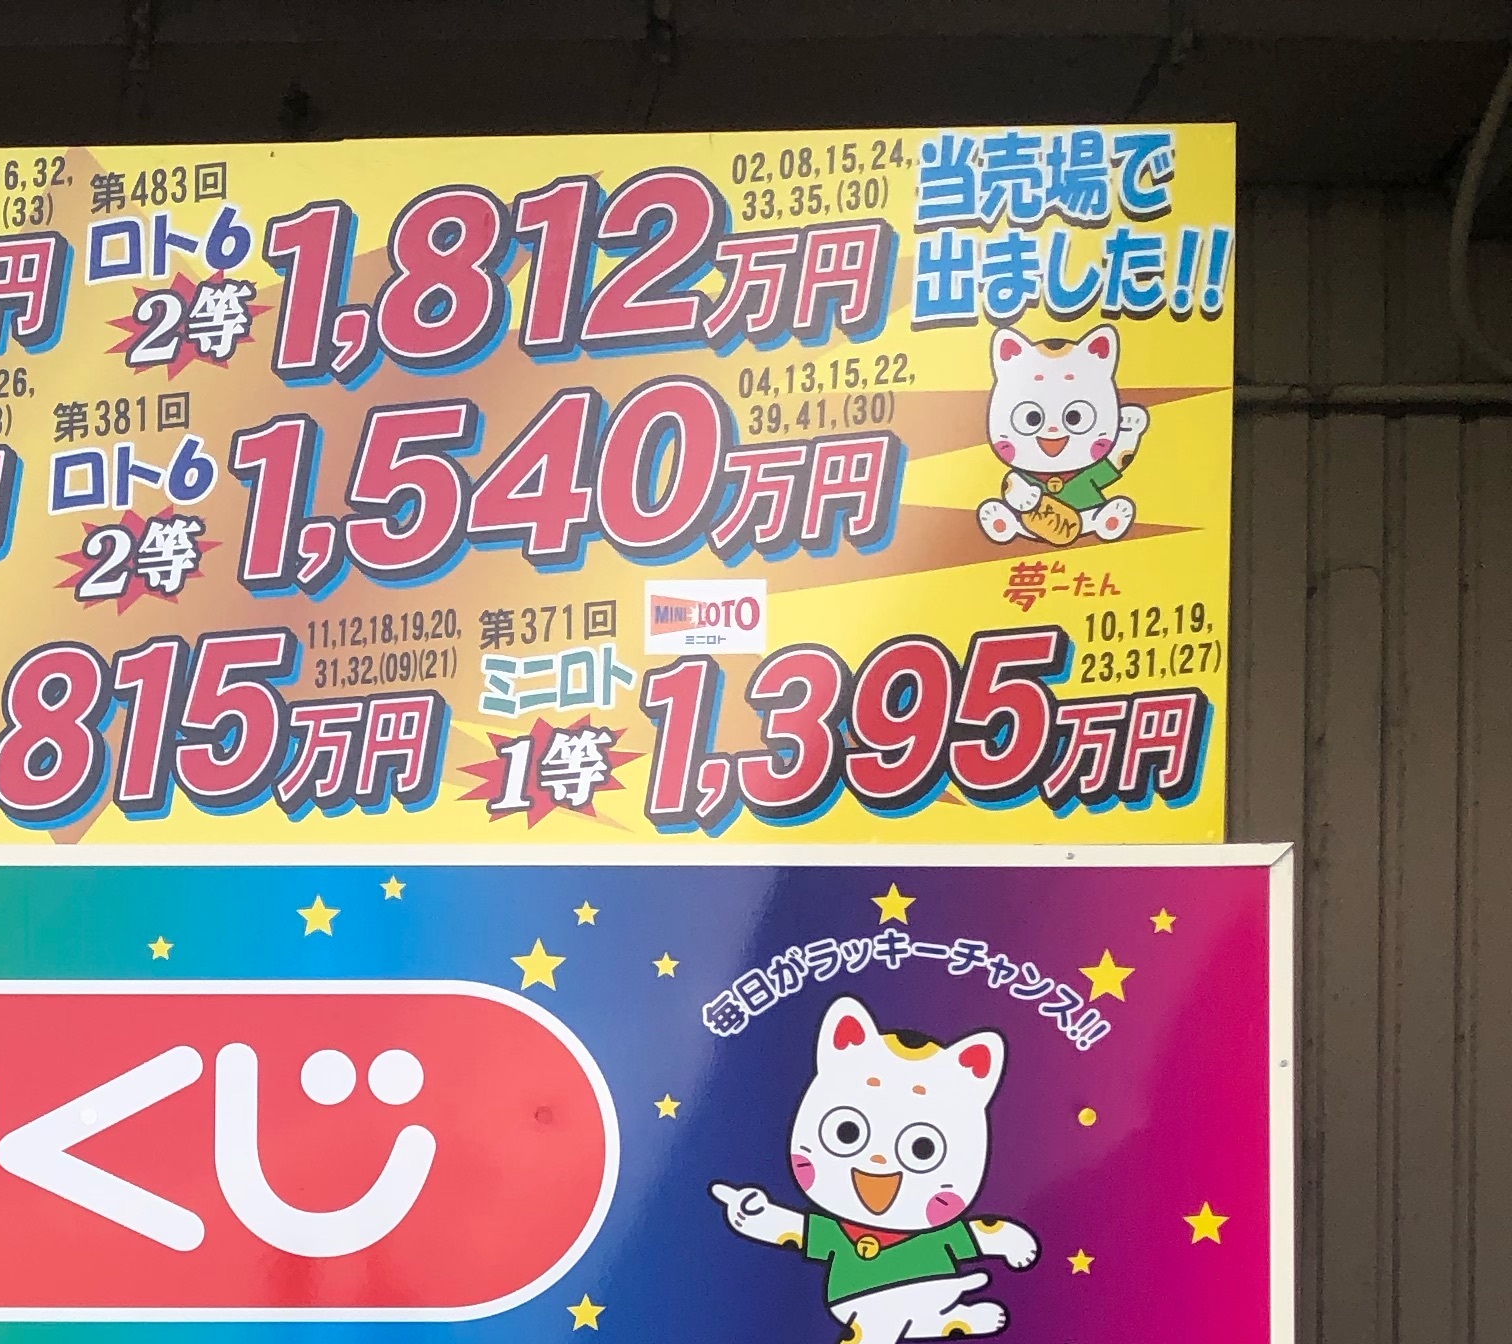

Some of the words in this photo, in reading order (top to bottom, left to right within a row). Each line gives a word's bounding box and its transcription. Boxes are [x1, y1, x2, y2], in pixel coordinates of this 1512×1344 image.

[90, 163, 228, 214] 第483回
[731, 139, 916, 185] 02,08,15,24,
[916, 131, 1175, 222] 当売場で
[741, 176, 890, 222] 33,35,(30)
[87, 205, 254, 285] ロト6
[265, 168, 884, 380] 1,812万円
[913, 227, 1233, 320] 出ました!!
[130, 280, 254, 366] 2等
[738, 353, 916, 399] 04,13,15,22,
[54, 391, 190, 443] 第381回
[748, 391, 896, 436] 39,41,(30)
[49, 435, 217, 514] ロト6
[232, 377, 896, 592] 1,540万円
[79, 515, 201, 601] 2等
[478, 599, 618, 651] 第371回
[691, 596, 760, 630] LOTO
[1083, 601, 1215, 644] 10,12,19,
[314, 648, 460, 689] 31,32,(09)(21)
[480, 645, 635, 717] ミニロト
[1080, 640, 1223, 685] 23,31,(27)
[641, 628, 1202, 833] 1,395万円
[488, 727, 617, 815] 1等
[701, 928, 1112, 1051] 毎日がラッキーチャンス!!
